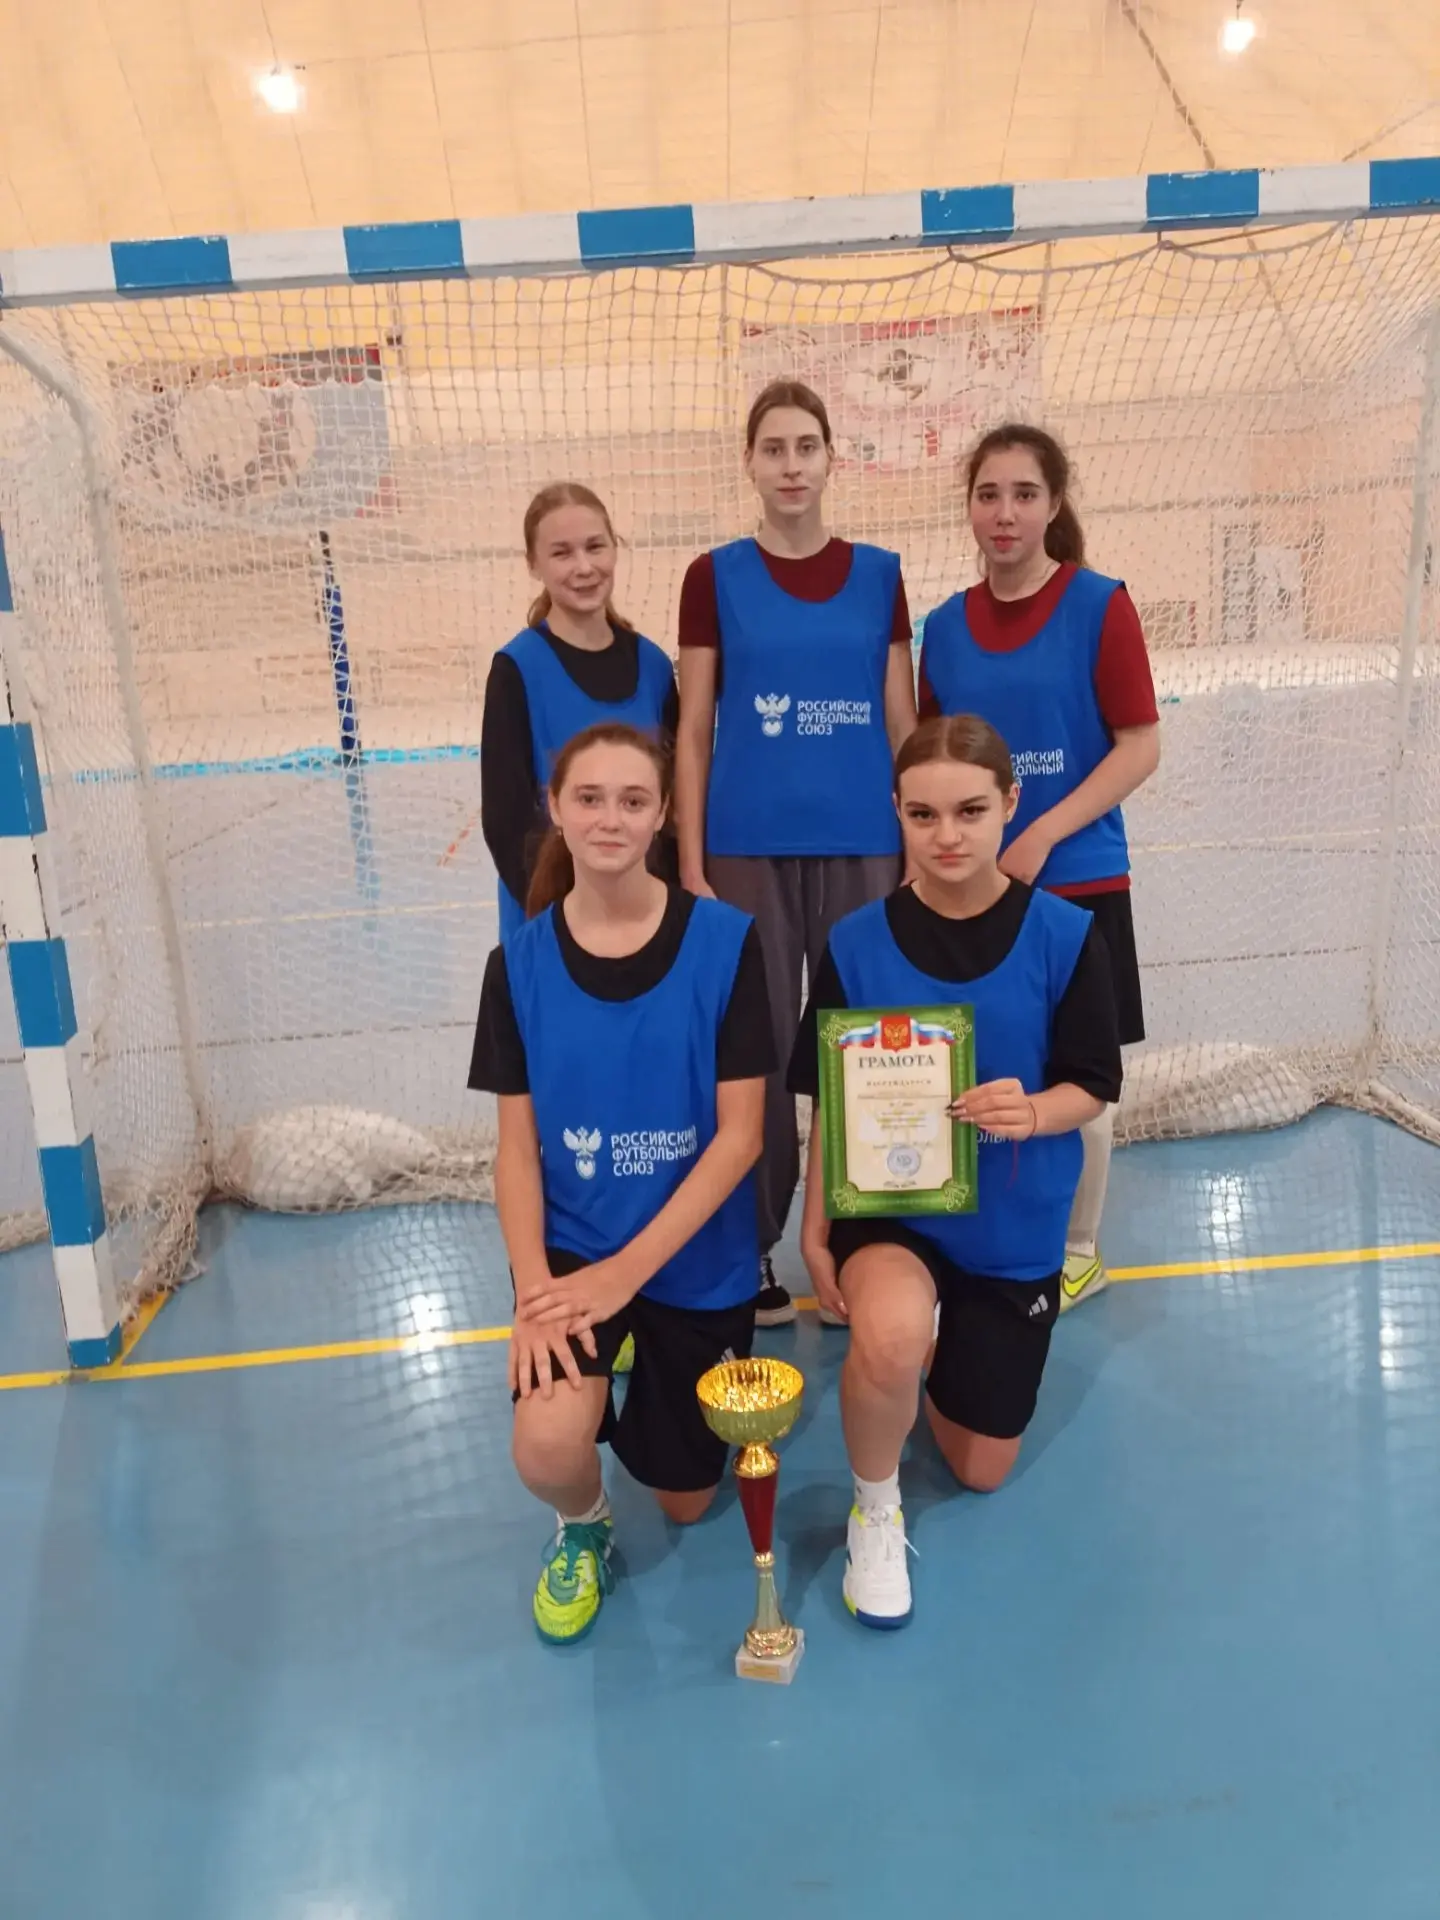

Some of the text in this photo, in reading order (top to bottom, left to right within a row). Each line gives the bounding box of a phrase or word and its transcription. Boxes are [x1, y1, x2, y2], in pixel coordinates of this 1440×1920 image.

[797, 723, 833, 736] СОЮЗ
[858, 1054, 936, 1070] ГРАМОТА
[612, 1161, 654, 1177] СОЮЗ
